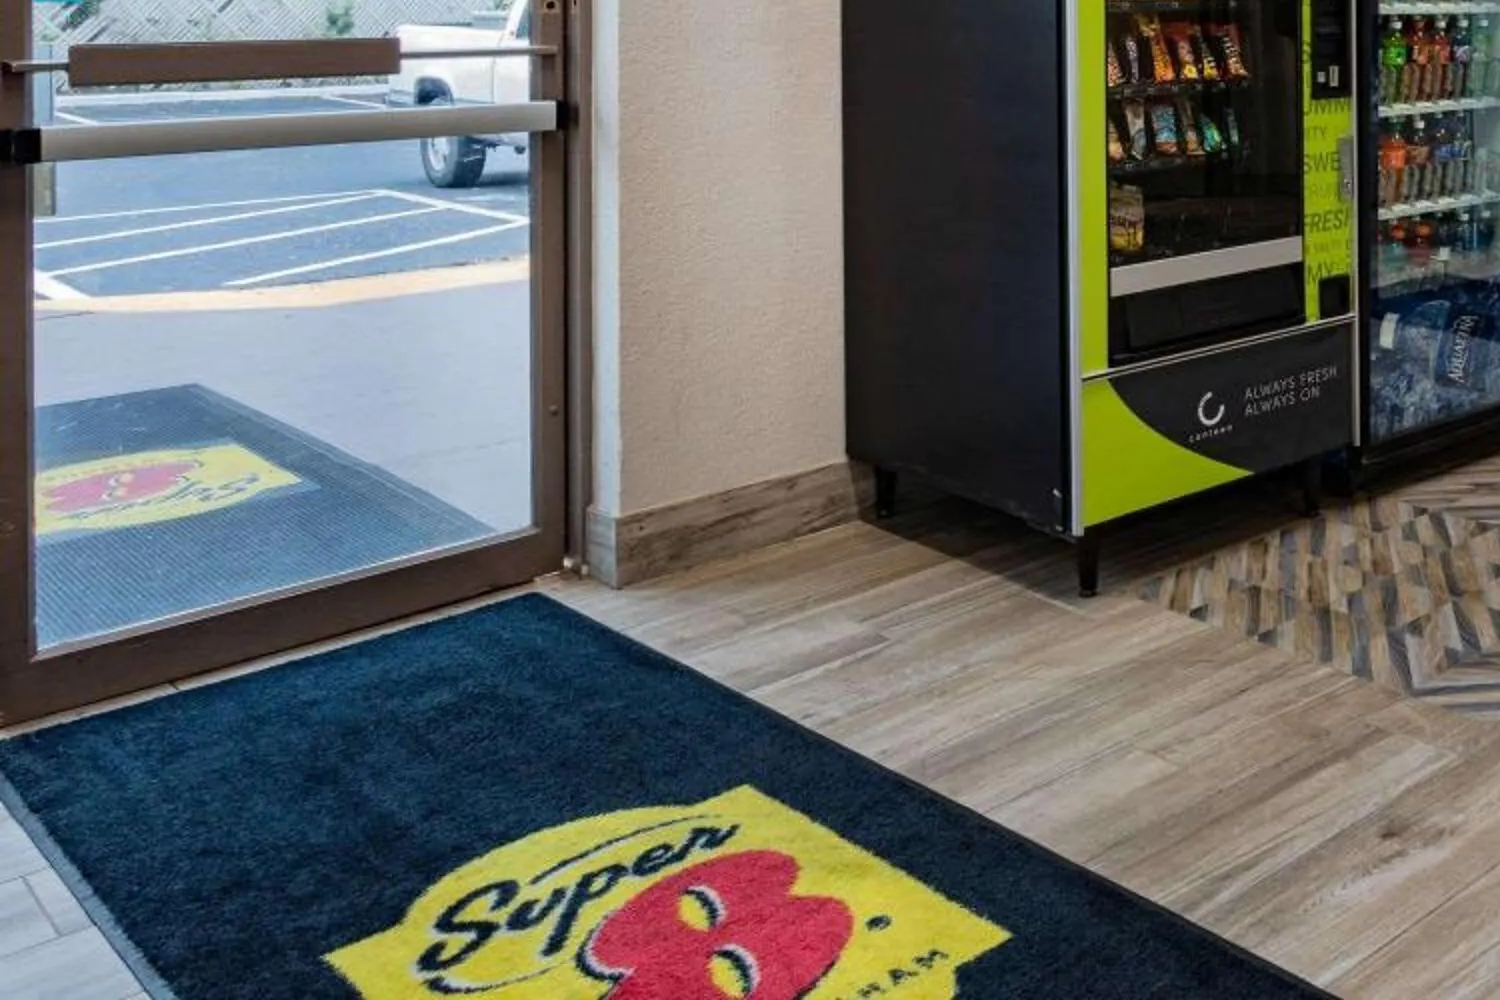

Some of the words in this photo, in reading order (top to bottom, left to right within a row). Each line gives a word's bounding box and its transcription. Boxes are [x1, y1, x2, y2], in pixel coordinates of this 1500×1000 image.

[1244, 375, 1296, 402] ALWAYS
[1299, 365, 1338, 387] FRESH
[1244, 390, 1296, 416] ALWAYS
[1300, 385, 1321, 402] ON
[416, 824, 740, 972] Super
